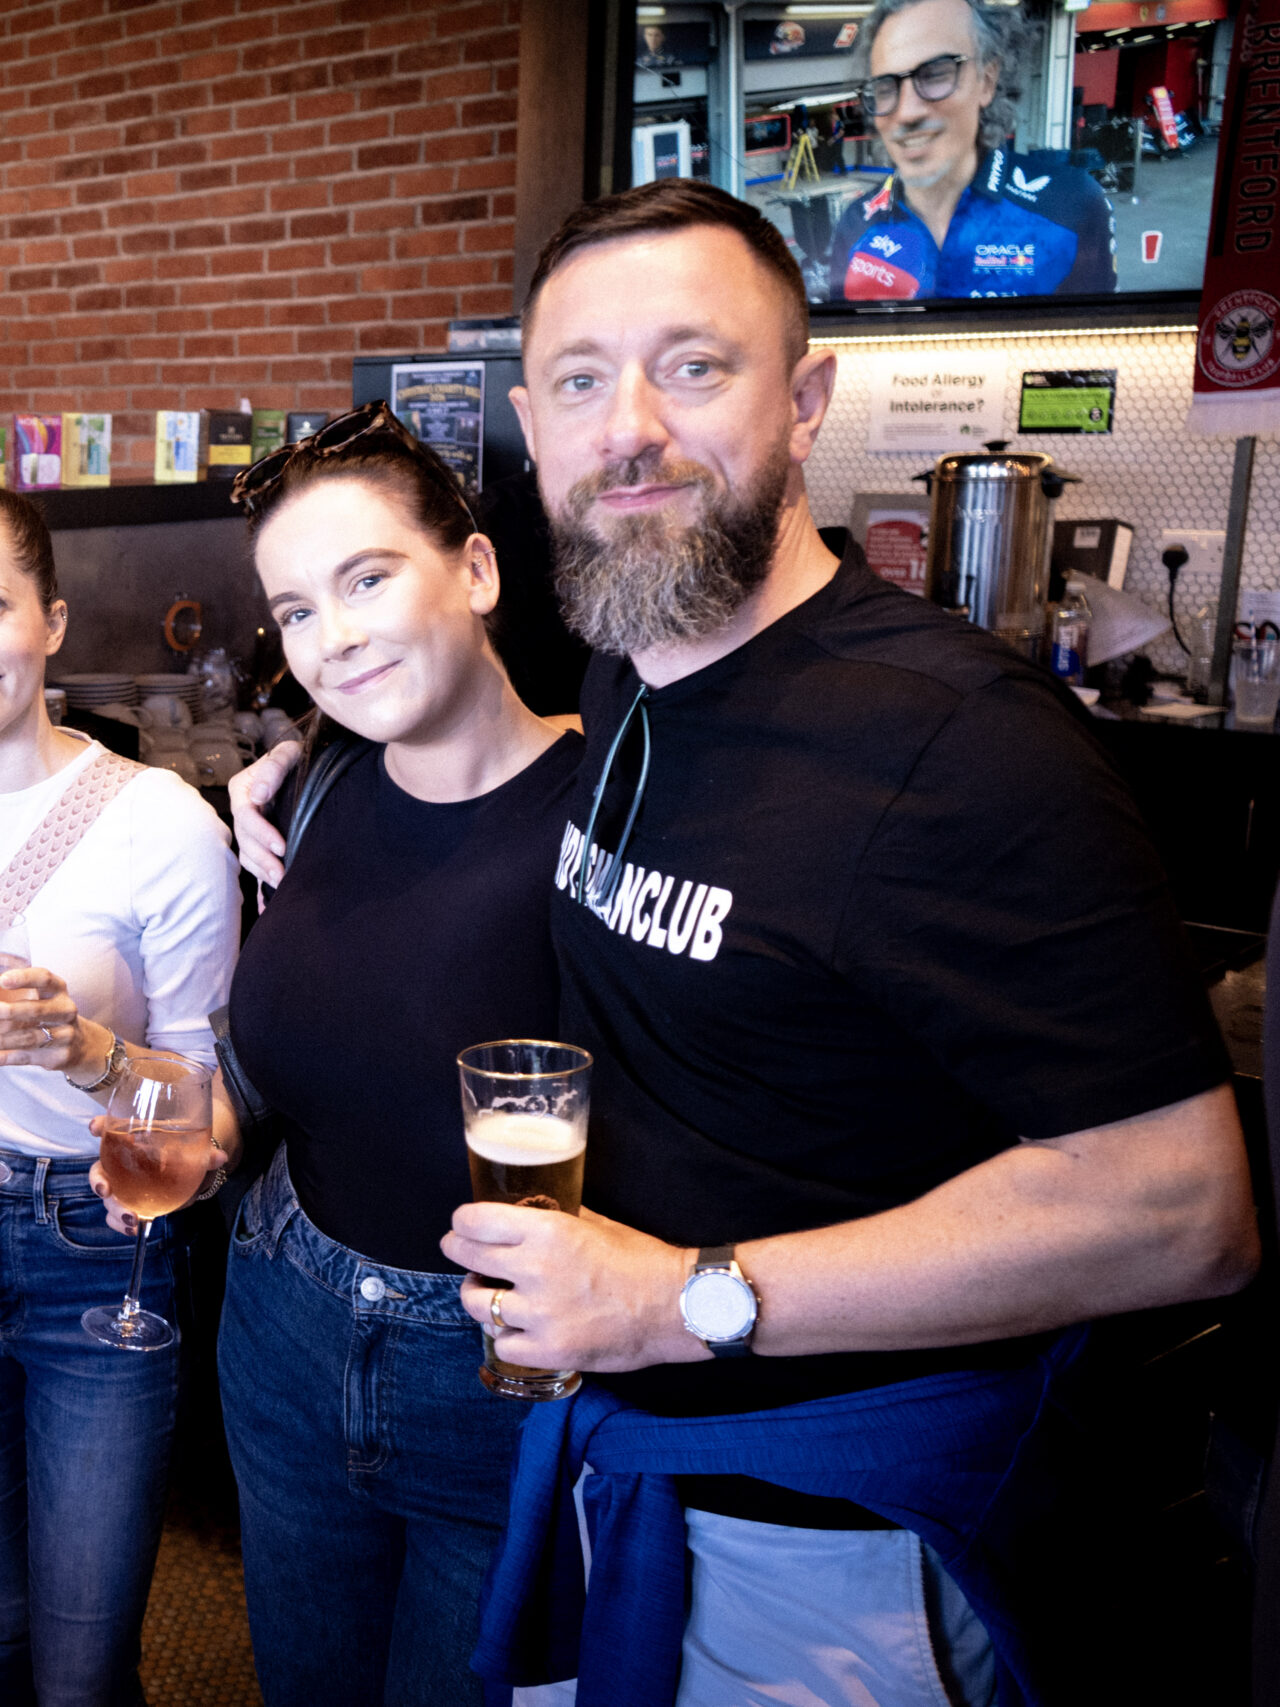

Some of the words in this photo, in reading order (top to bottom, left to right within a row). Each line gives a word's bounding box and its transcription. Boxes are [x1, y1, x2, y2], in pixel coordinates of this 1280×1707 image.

[870, 234, 903, 258] sky
[975, 244, 1036, 256] ORACLE
[850, 257, 896, 288] sports
[892, 373, 928, 387] Food
[932, 373, 986, 390] Allergy
[889, 399, 985, 414] Intolerance?
